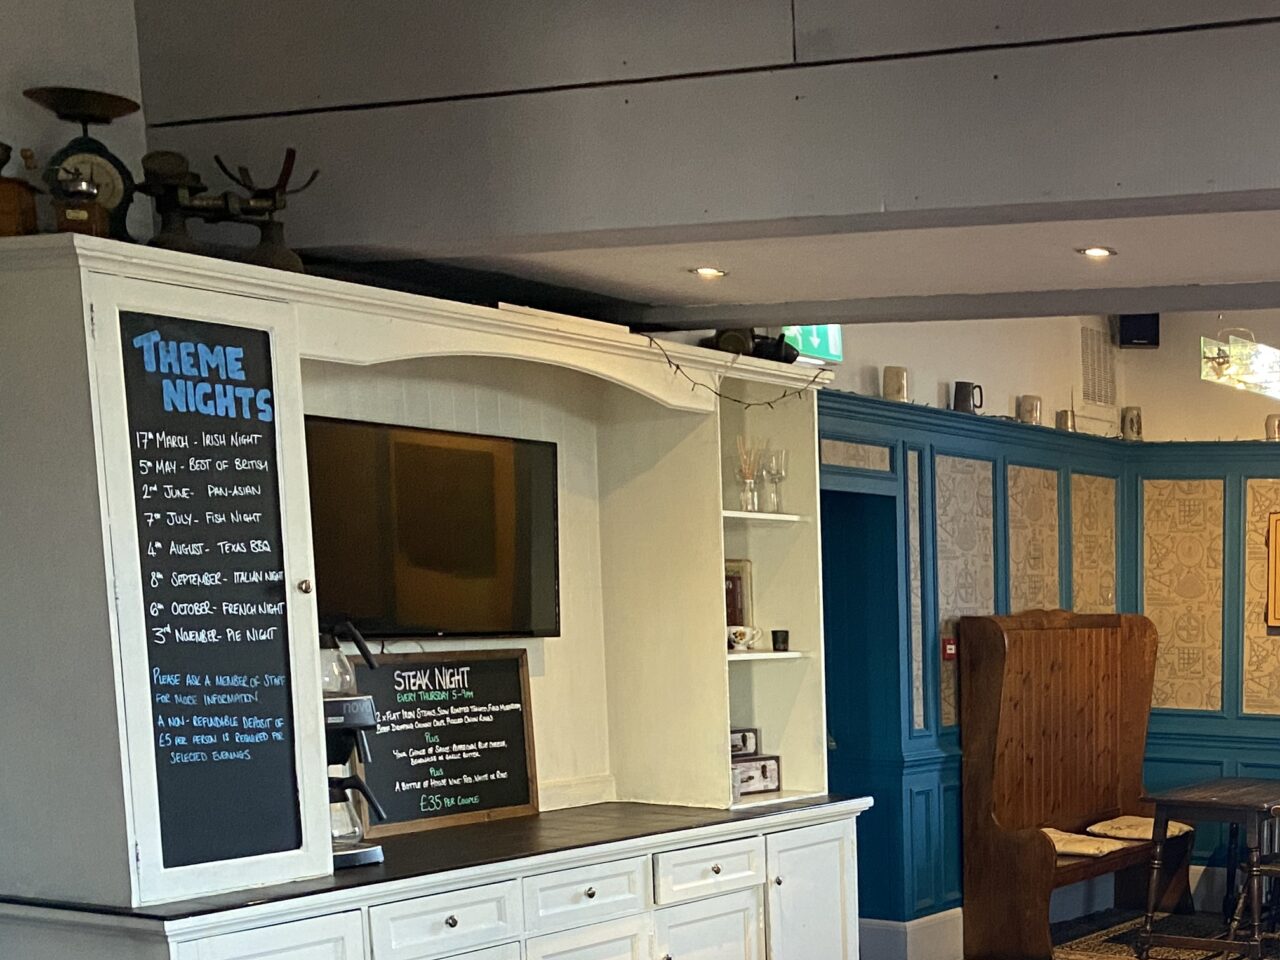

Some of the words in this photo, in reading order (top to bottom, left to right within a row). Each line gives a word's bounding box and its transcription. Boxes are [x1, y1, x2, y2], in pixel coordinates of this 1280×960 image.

[133, 330, 245, 380] THEME
[162, 379, 273, 422] NIGHTS
[156, 431, 189, 448] MARCH
[202, 432, 226, 447] IRISH
[231, 432, 262, 447] NIGHT
[156, 459, 177, 474] MAY
[189, 457, 212, 471] BEST
[216, 460, 229, 471] OF
[235, 458, 269, 472] BRITISH
[206, 512, 226, 524] FISH
[230, 510, 262, 523] NIGHT
[217, 541, 247, 554] TEXAS
[250, 540, 271, 553] BBQ
[234, 571, 262, 584] ITALIAN
[265, 571, 284, 582] NIGHT
[222, 602, 256, 615] FRENCH
[259, 602, 285, 615] NIGHT
[226, 628, 241, 641] PIE
[246, 627, 277, 641] NIGHT
[153, 667, 180, 685] PLEASE
[186, 674, 201, 686] ASK
[205, 675, 211, 686] A
[216, 675, 249, 687] MEMBER
[249, 676, 260, 688] OF
[264, 674, 286, 687] STAFF
[394, 669, 433, 690] STEAK
[435, 666, 470, 690] NIGHT
[156, 693, 170, 703] FOR
[396, 692, 416, 703] EVERY
[418, 690, 449, 701] THURSDAY
[158, 715, 165, 727] A
[243, 716, 272, 728] DEPOSIT
[275, 718, 284, 728] OF
[159, 733, 171, 747] £5
[175, 736, 188, 745] PER
[193, 735, 217, 744] PERSON
[223, 732, 229, 742] IS
[272, 732, 284, 741] FOR
[424, 732, 440, 743] PLUS
[170, 751, 207, 764] SELECTED
[429, 767, 443, 777] PLUS
[420, 794, 441, 812] £35
[443, 797, 455, 808] PER
